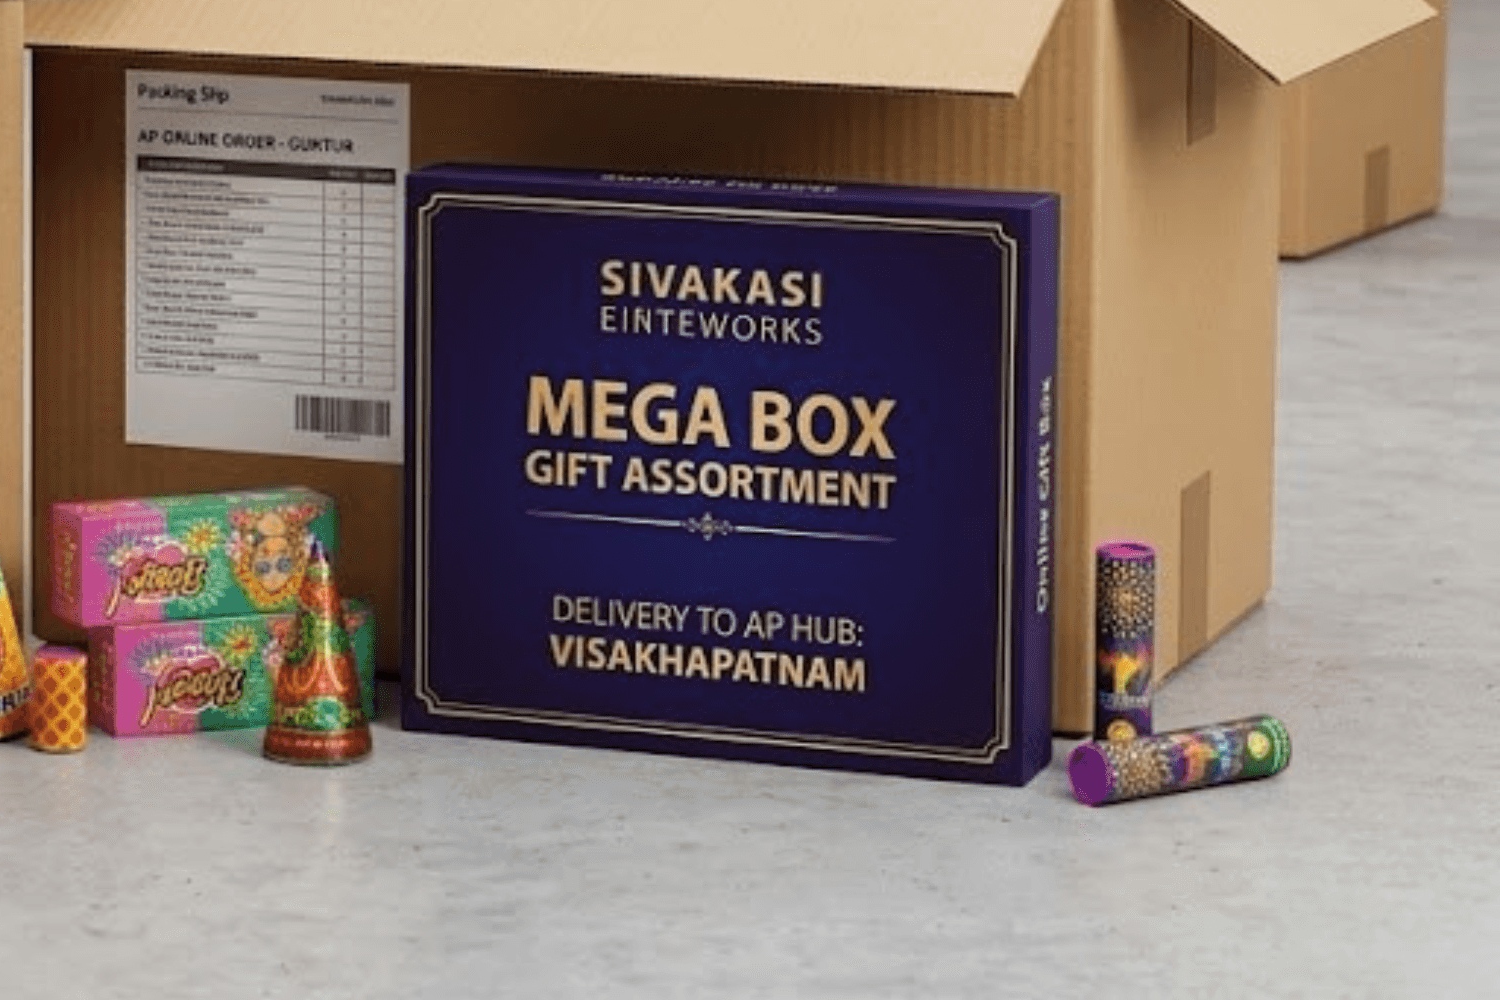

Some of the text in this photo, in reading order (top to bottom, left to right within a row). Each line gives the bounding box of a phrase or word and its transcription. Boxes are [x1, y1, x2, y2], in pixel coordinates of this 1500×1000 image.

[599, 258, 824, 309] SIVAKASI
[599, 304, 825, 346] EINTEWORKS
[524, 373, 897, 461] MEGA BOX
[524, 448, 897, 511] GIFT ASSORTMENT
[551, 594, 865, 648] DELIVERY TO AP HUB:
[549, 633, 866, 693] VISAKHAPATNAM
